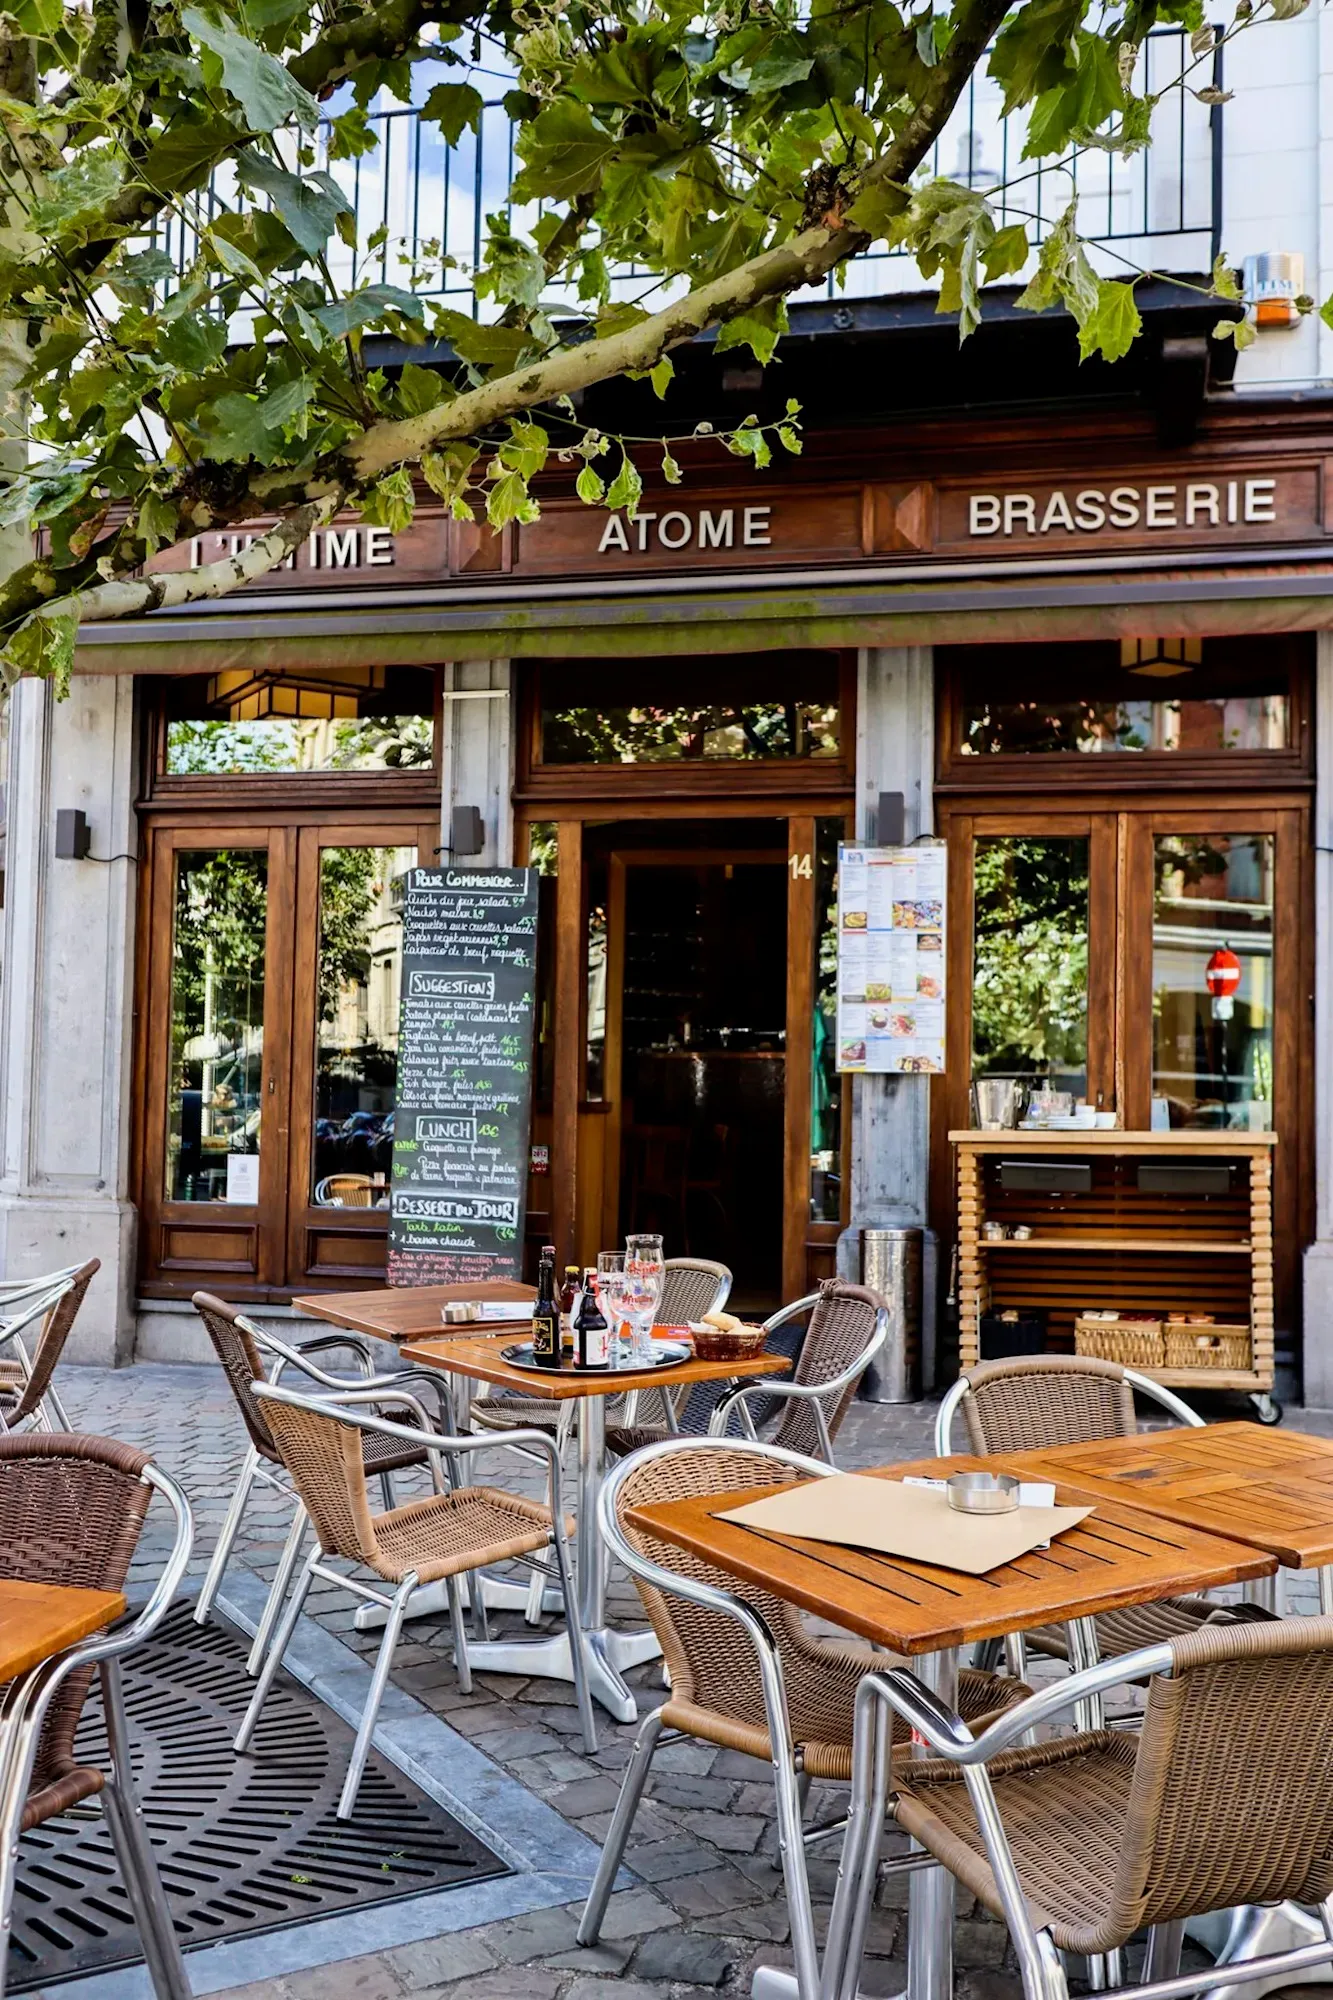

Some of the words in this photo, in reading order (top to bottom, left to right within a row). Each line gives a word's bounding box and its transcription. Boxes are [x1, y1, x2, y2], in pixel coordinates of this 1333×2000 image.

[968, 479, 1277, 536] BRASSERIE
[598, 506, 773, 553] ATOME
[190, 526, 393, 569] L'IME
[788, 854, 813, 880] 14
[408, 893, 438, 905] Quiche
[440, 895, 455, 905] du
[408, 906, 437, 917] Nachos
[406, 919, 447, 934] Croquettes
[449, 922, 467, 931] aux
[405, 930, 430, 945] Tapas
[405, 943, 447, 957] Carpaccio
[448, 947, 460, 956] de
[414, 974, 494, 995] SUGGESTIONS
[435, 1001, 451, 1009] aux
[442, 1032, 452, 1041] de
[420, 1120, 470, 1138] LUNCH
[457, 1145, 468, 1153] au
[398, 1197, 456, 1217] DESSERT
[471, 1200, 514, 1220] JOUR
